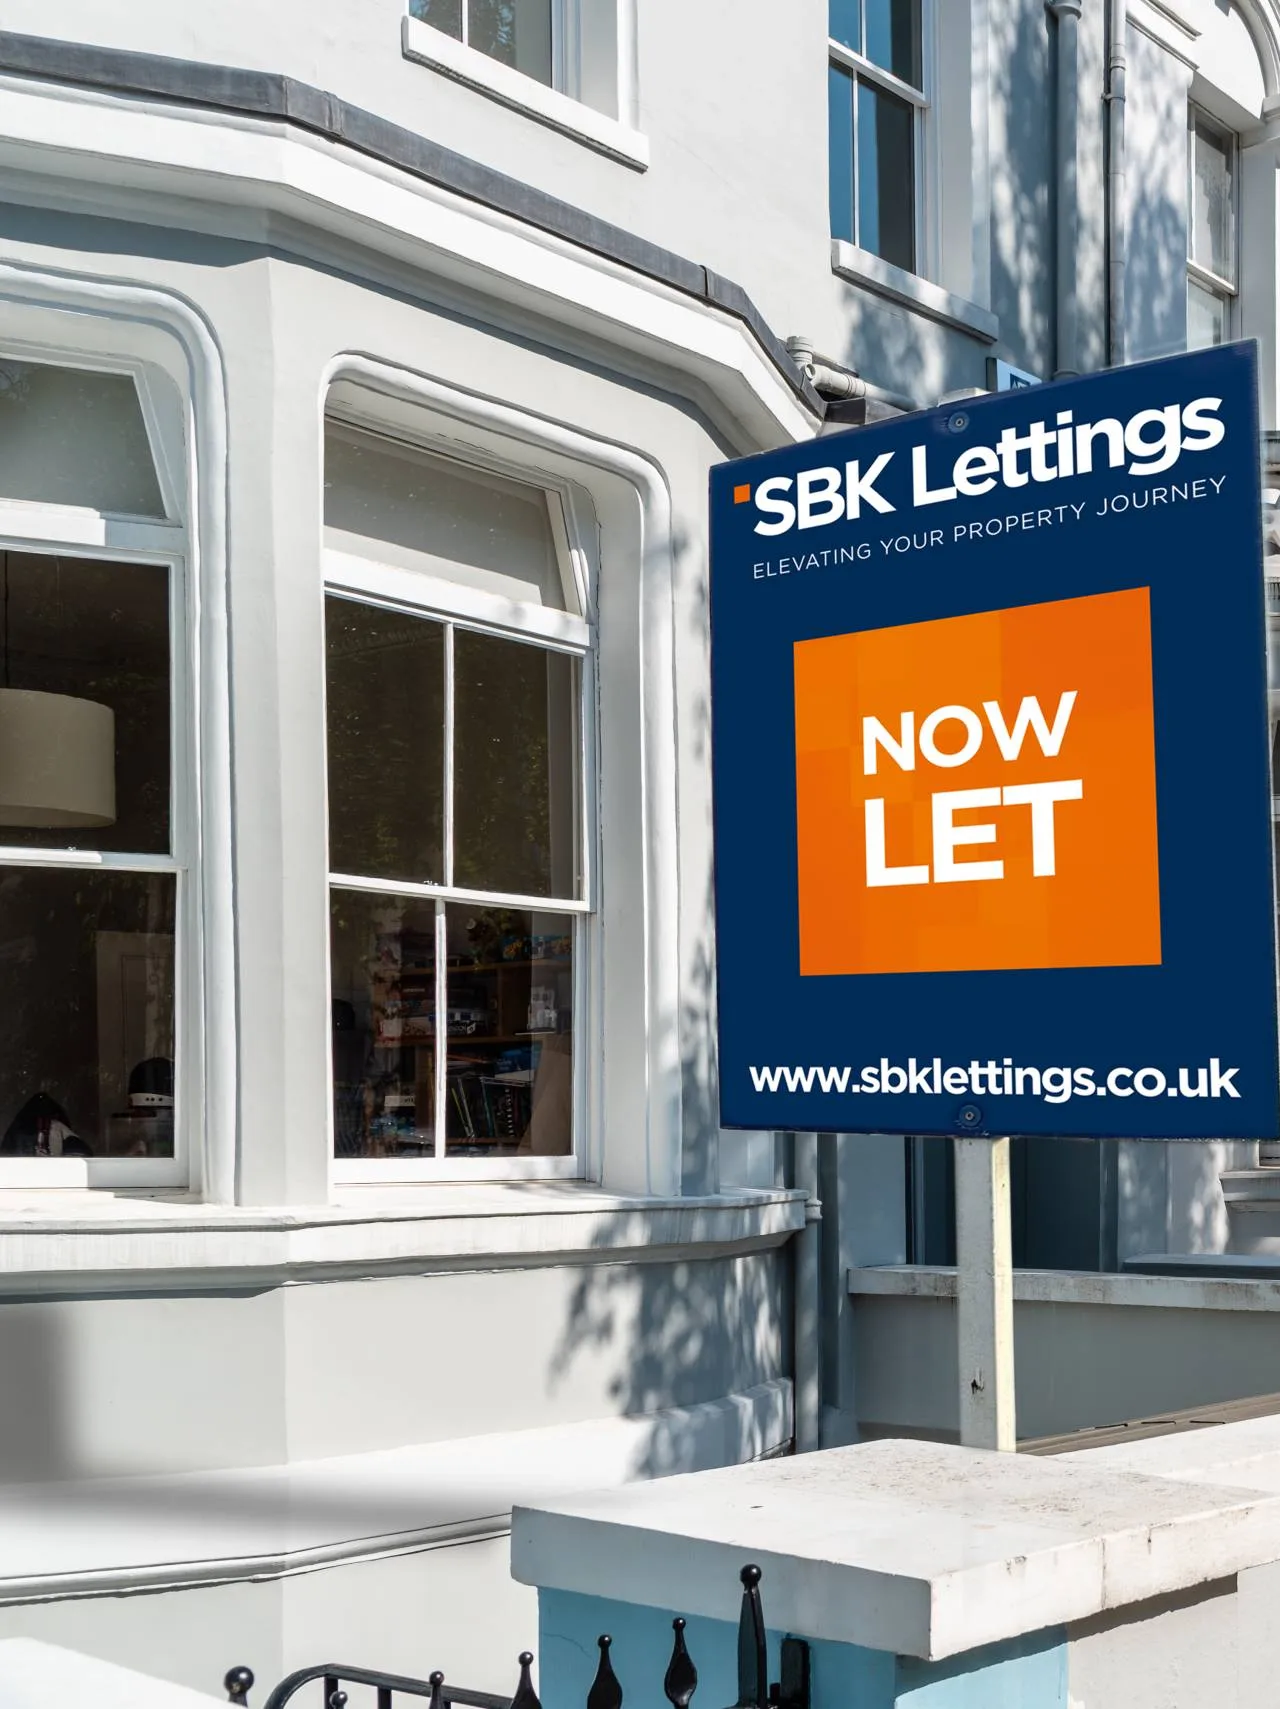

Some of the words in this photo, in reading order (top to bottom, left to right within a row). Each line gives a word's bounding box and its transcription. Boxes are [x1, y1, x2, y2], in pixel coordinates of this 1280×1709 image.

[753, 452, 897, 537] SBK
[912, 397, 1226, 507] Lettings
[753, 543, 871, 579] ELEVATING
[880, 530, 944, 555] YOUR
[954, 502, 1085, 542] PROPERTY
[1097, 475, 1227, 516] JOURNEY
[862, 690, 1078, 775] NOW
[864, 779, 1083, 887] LET
[749, 1057, 1242, 1104] www.sbklettings.co.uk
